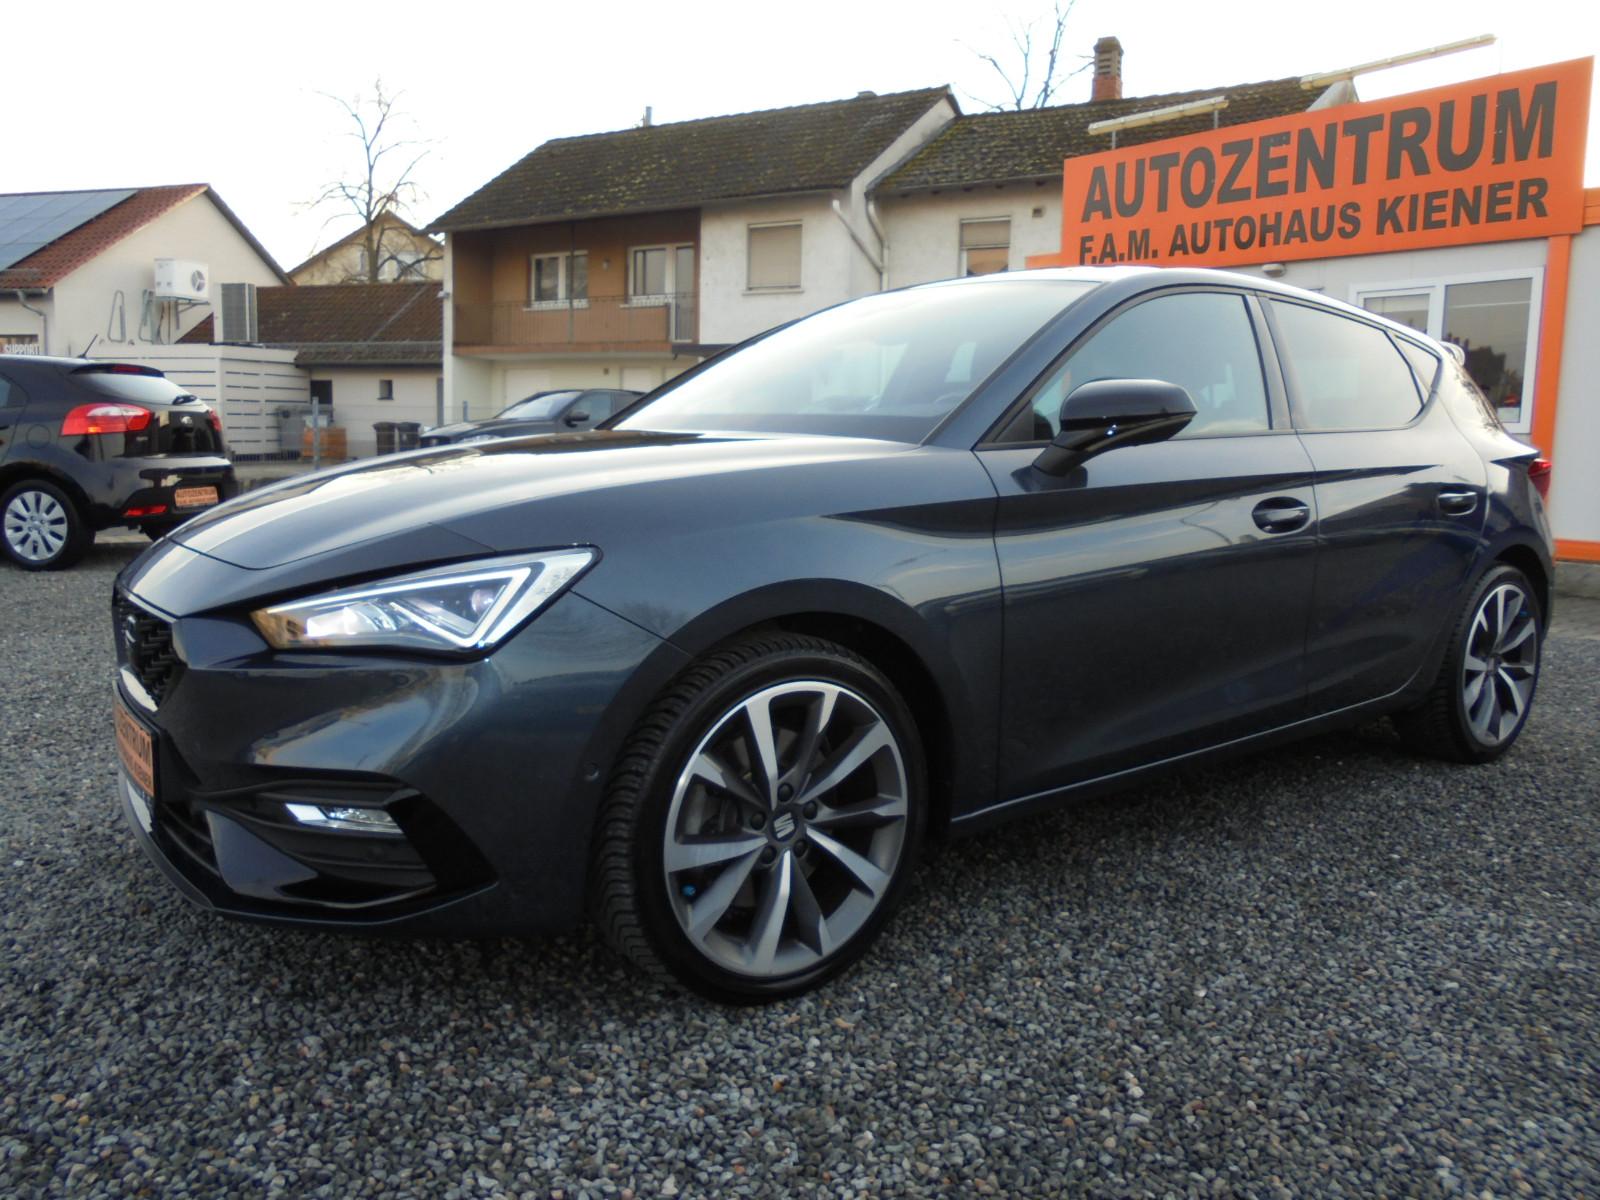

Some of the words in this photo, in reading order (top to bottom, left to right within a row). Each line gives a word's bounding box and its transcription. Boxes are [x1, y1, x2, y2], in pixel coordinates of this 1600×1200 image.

[1081, 81, 1557, 223] AUTOZENTRUM
[1079, 228, 1159, 266] F.A.M.
[1168, 202, 1361, 257] AUTOHAUS
[1376, 177, 1548, 236] KIENER
